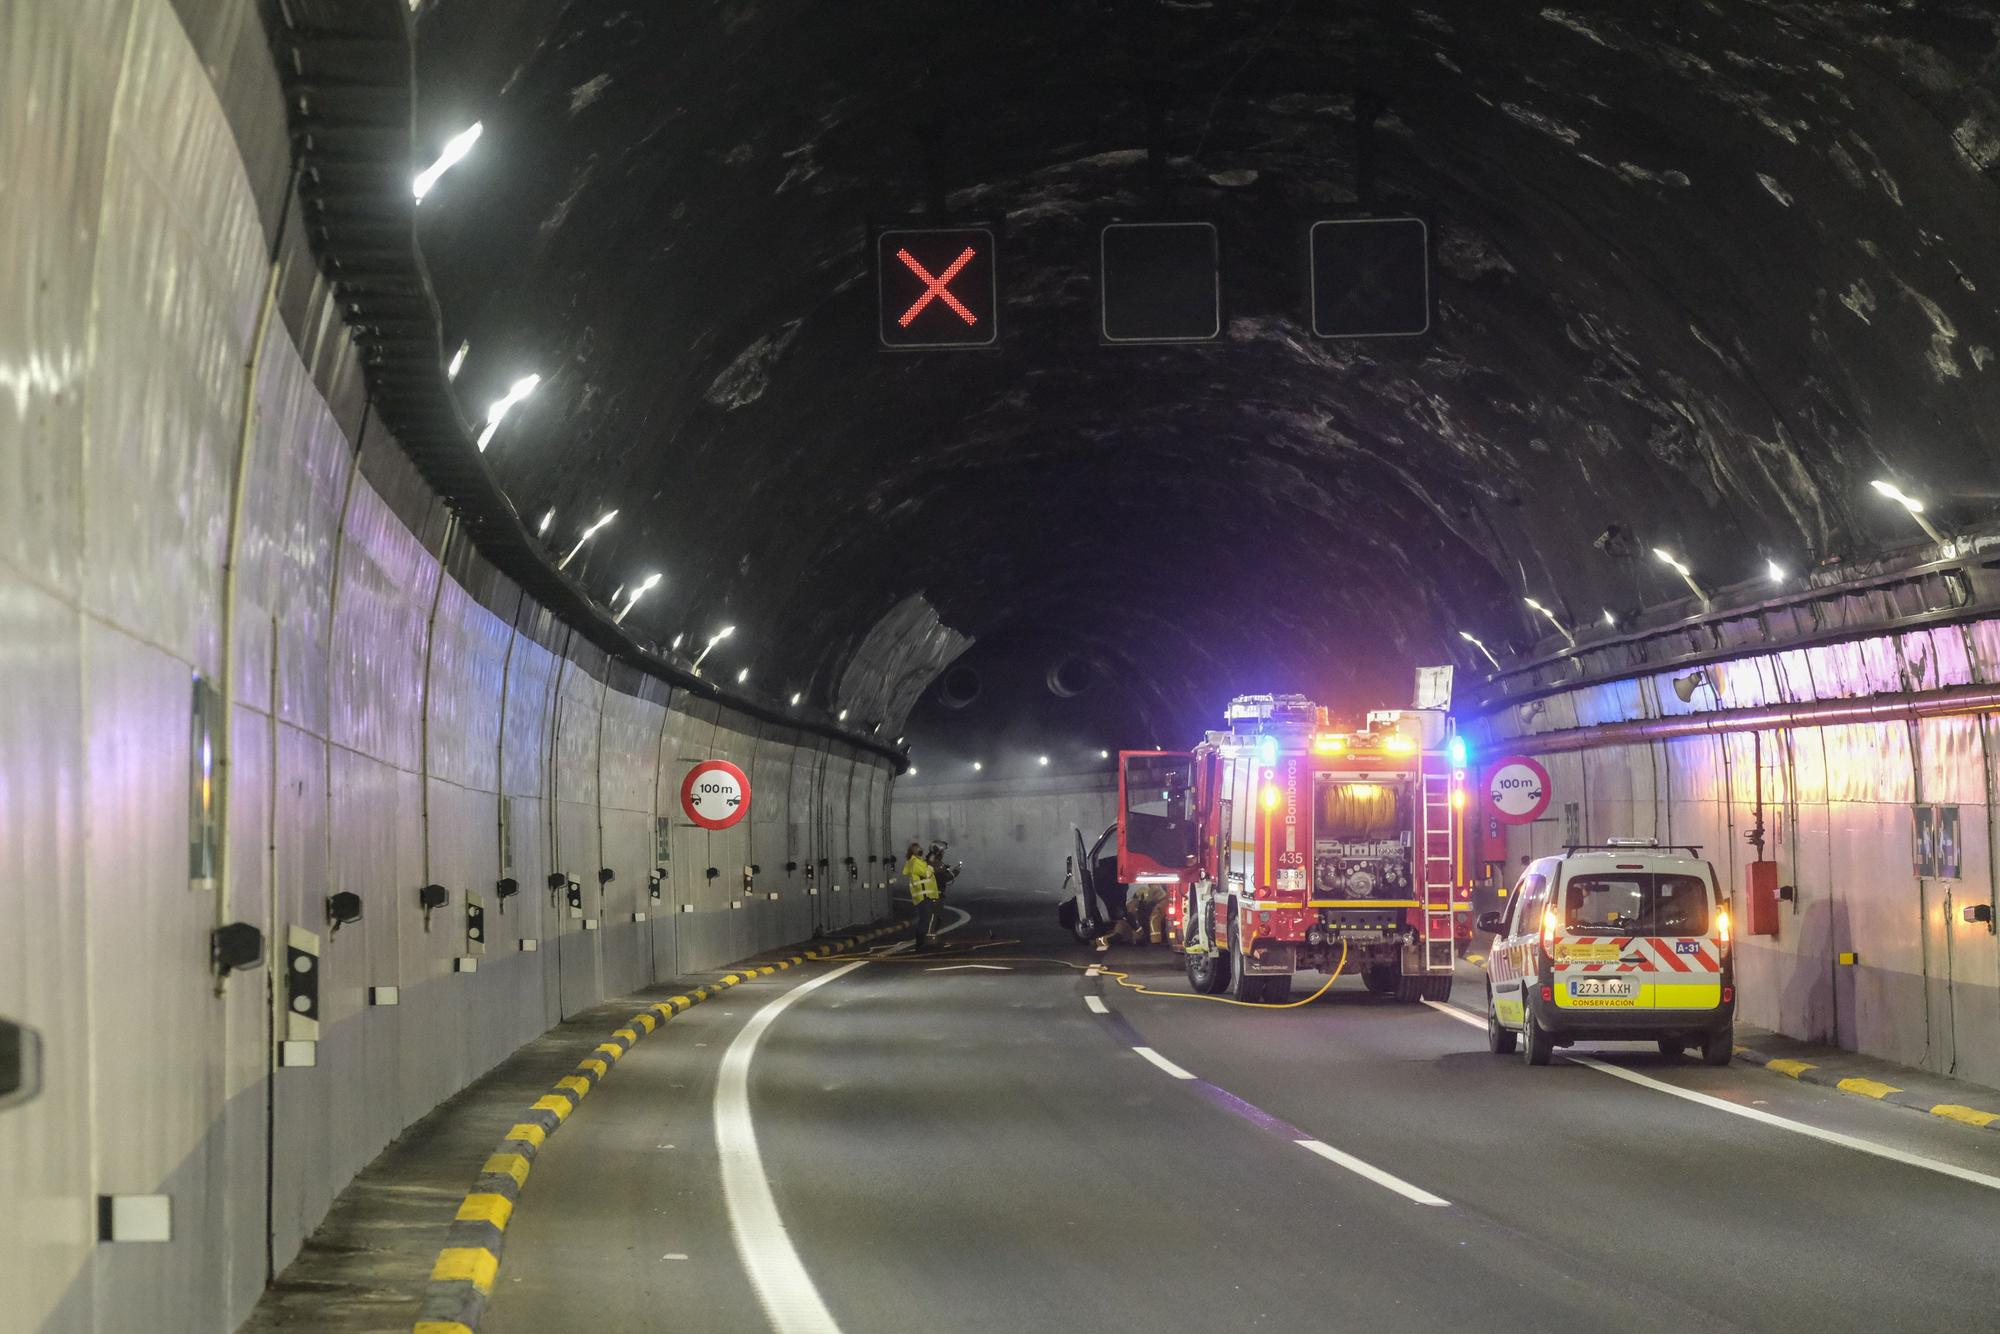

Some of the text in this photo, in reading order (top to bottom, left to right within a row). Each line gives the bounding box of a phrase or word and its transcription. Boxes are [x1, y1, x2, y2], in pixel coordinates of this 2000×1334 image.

[700, 784, 733, 794] 100 m
[1500, 779, 1533, 789] 100 m
[1285, 759, 1297, 824] Bomberos
[1279, 852, 1303, 864] 435
[1677, 943, 1699, 953] A-31
[1578, 983, 1631, 994] 2731 KXH
[1572, 999, 1635, 1007] CONSERVACIÓN
